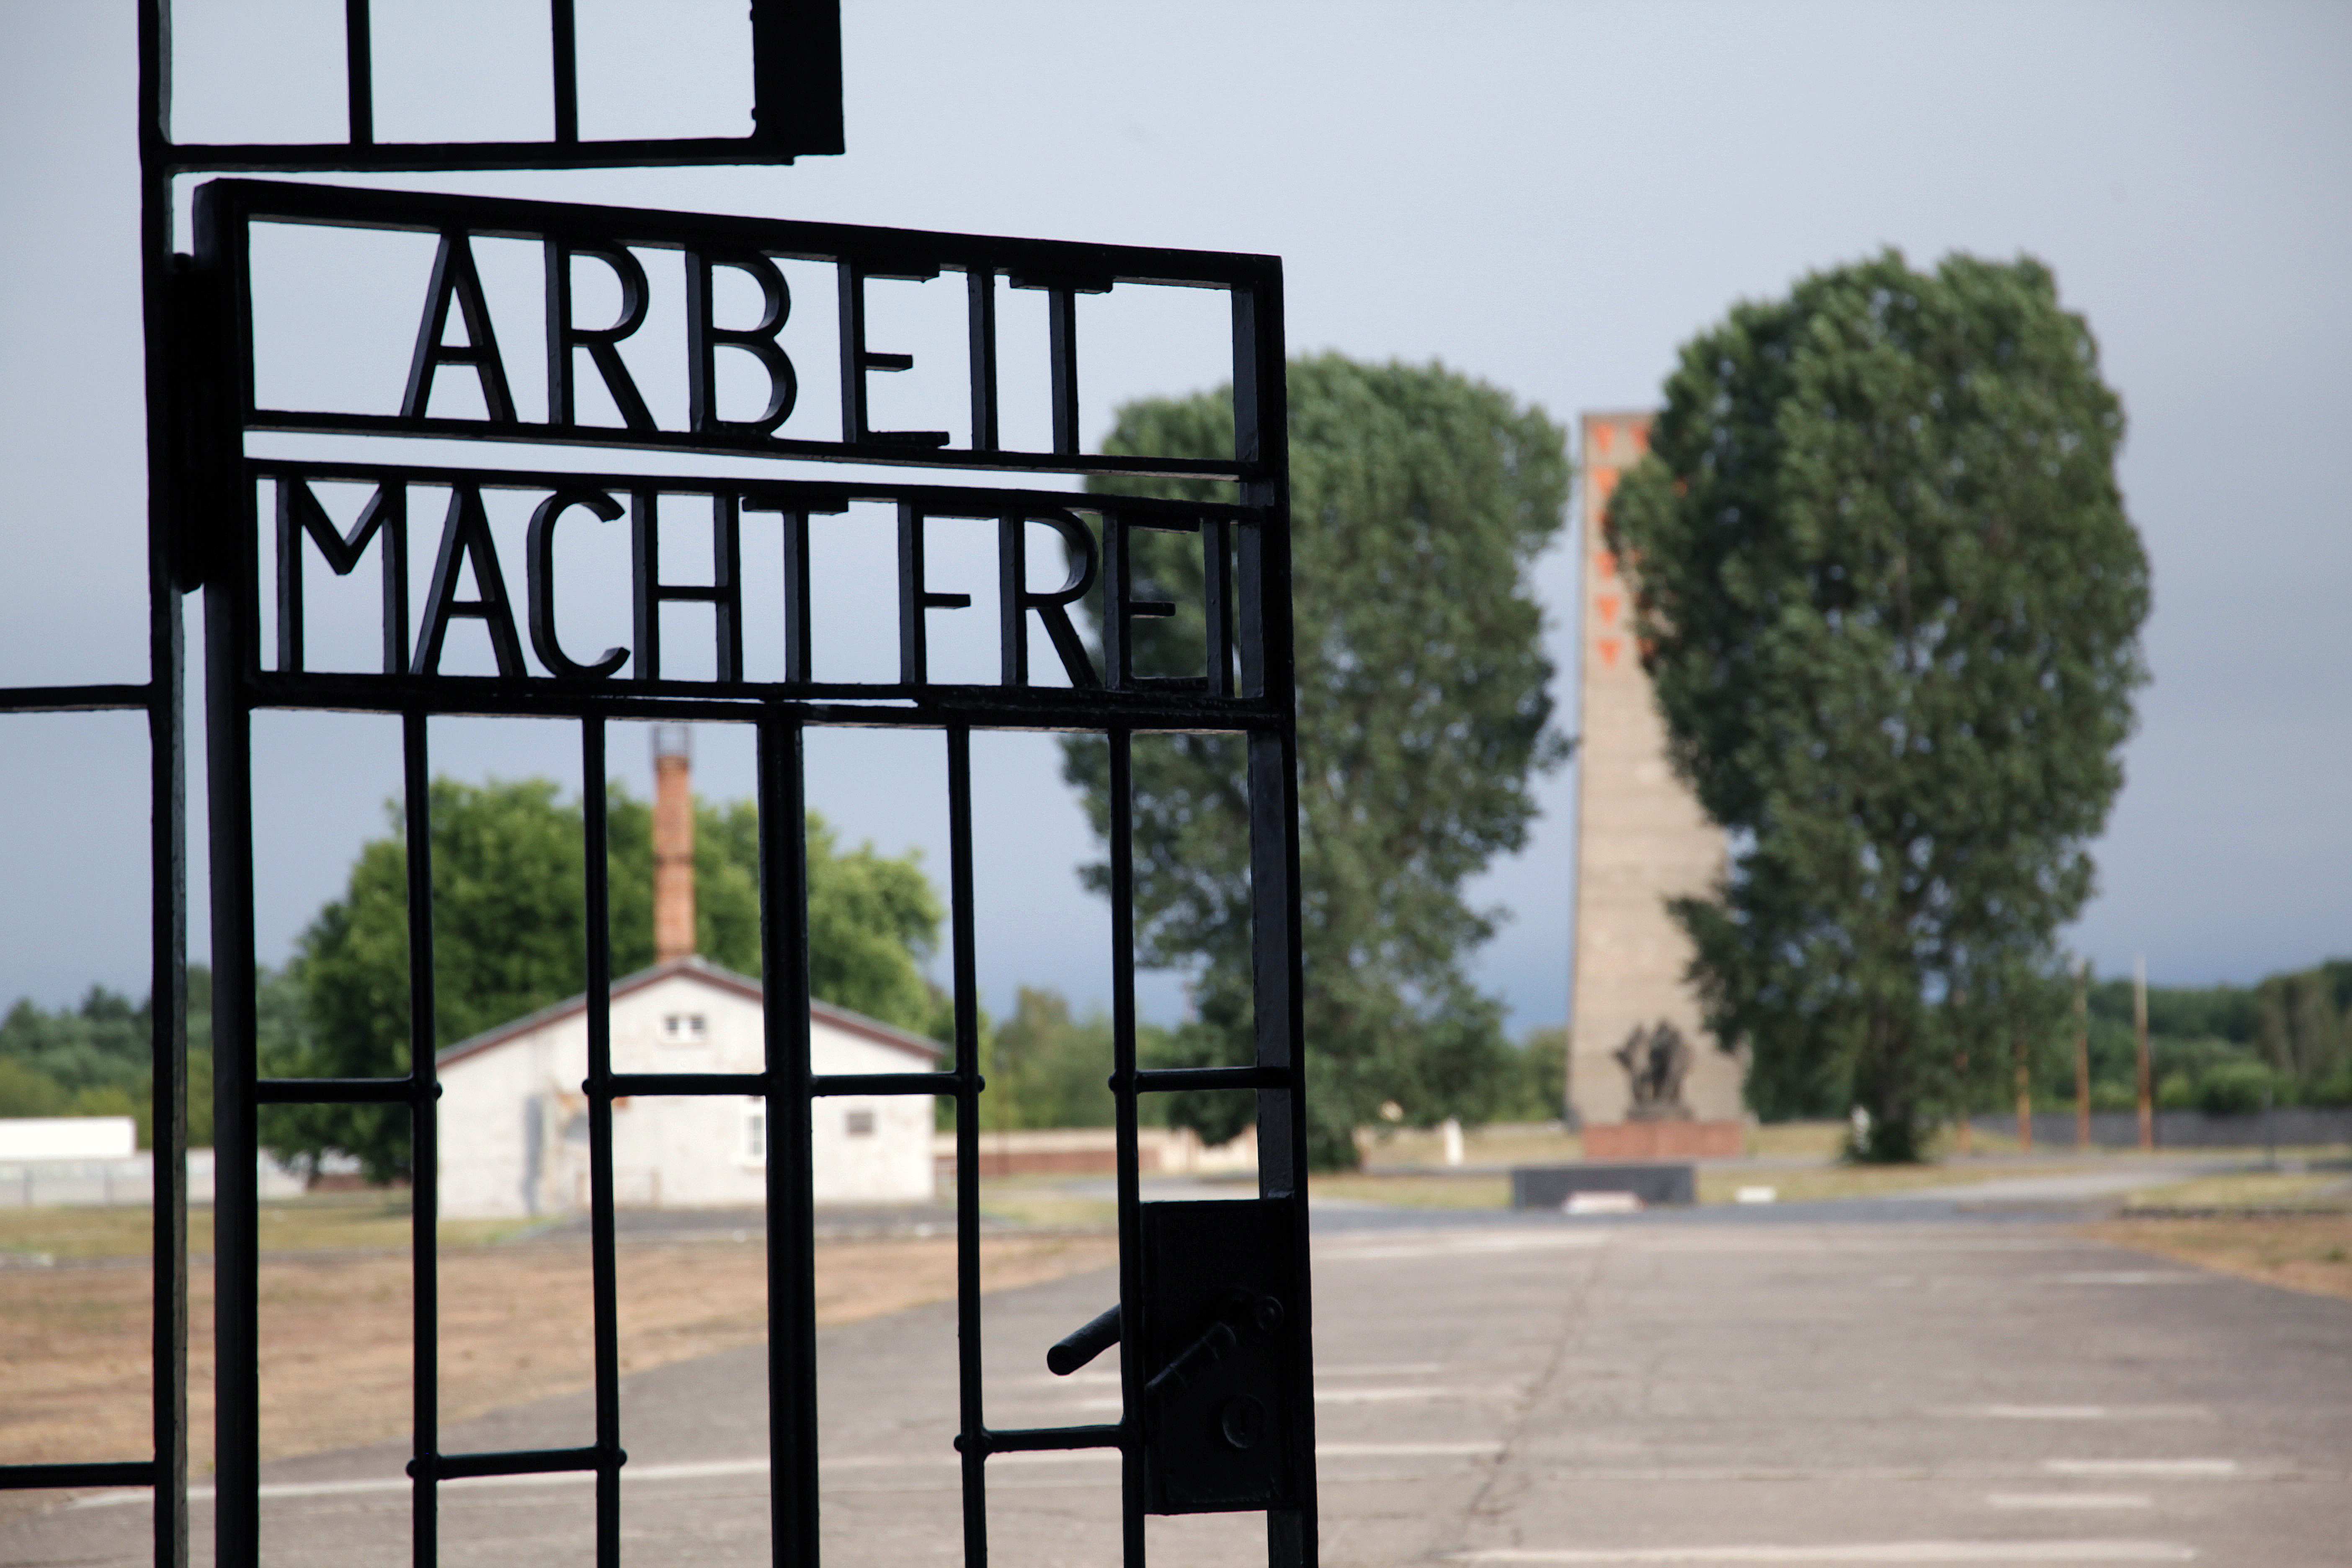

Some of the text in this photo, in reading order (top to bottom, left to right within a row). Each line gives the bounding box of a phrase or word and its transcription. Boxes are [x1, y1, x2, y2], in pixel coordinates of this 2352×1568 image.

[399, 228, 1114, 454] ARBEIT
[276, 474, 1235, 699] MACHT FREI
